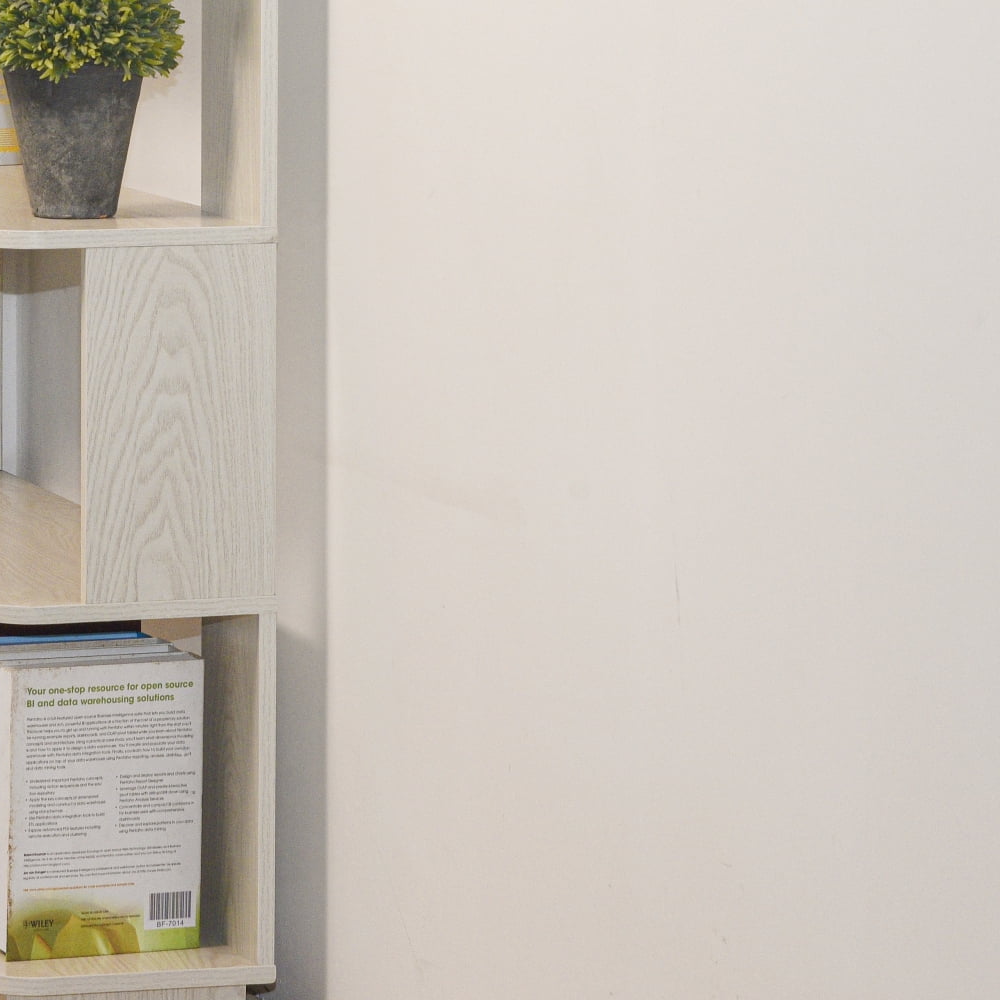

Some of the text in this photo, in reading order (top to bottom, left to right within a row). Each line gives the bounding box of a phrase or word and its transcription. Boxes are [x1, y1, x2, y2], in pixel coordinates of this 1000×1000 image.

[27, 680, 194, 695] Your one-stop resource for open source
[26, 693, 175, 708] BI and data warehousing solutions
[30, 919, 54, 928] WILEY
